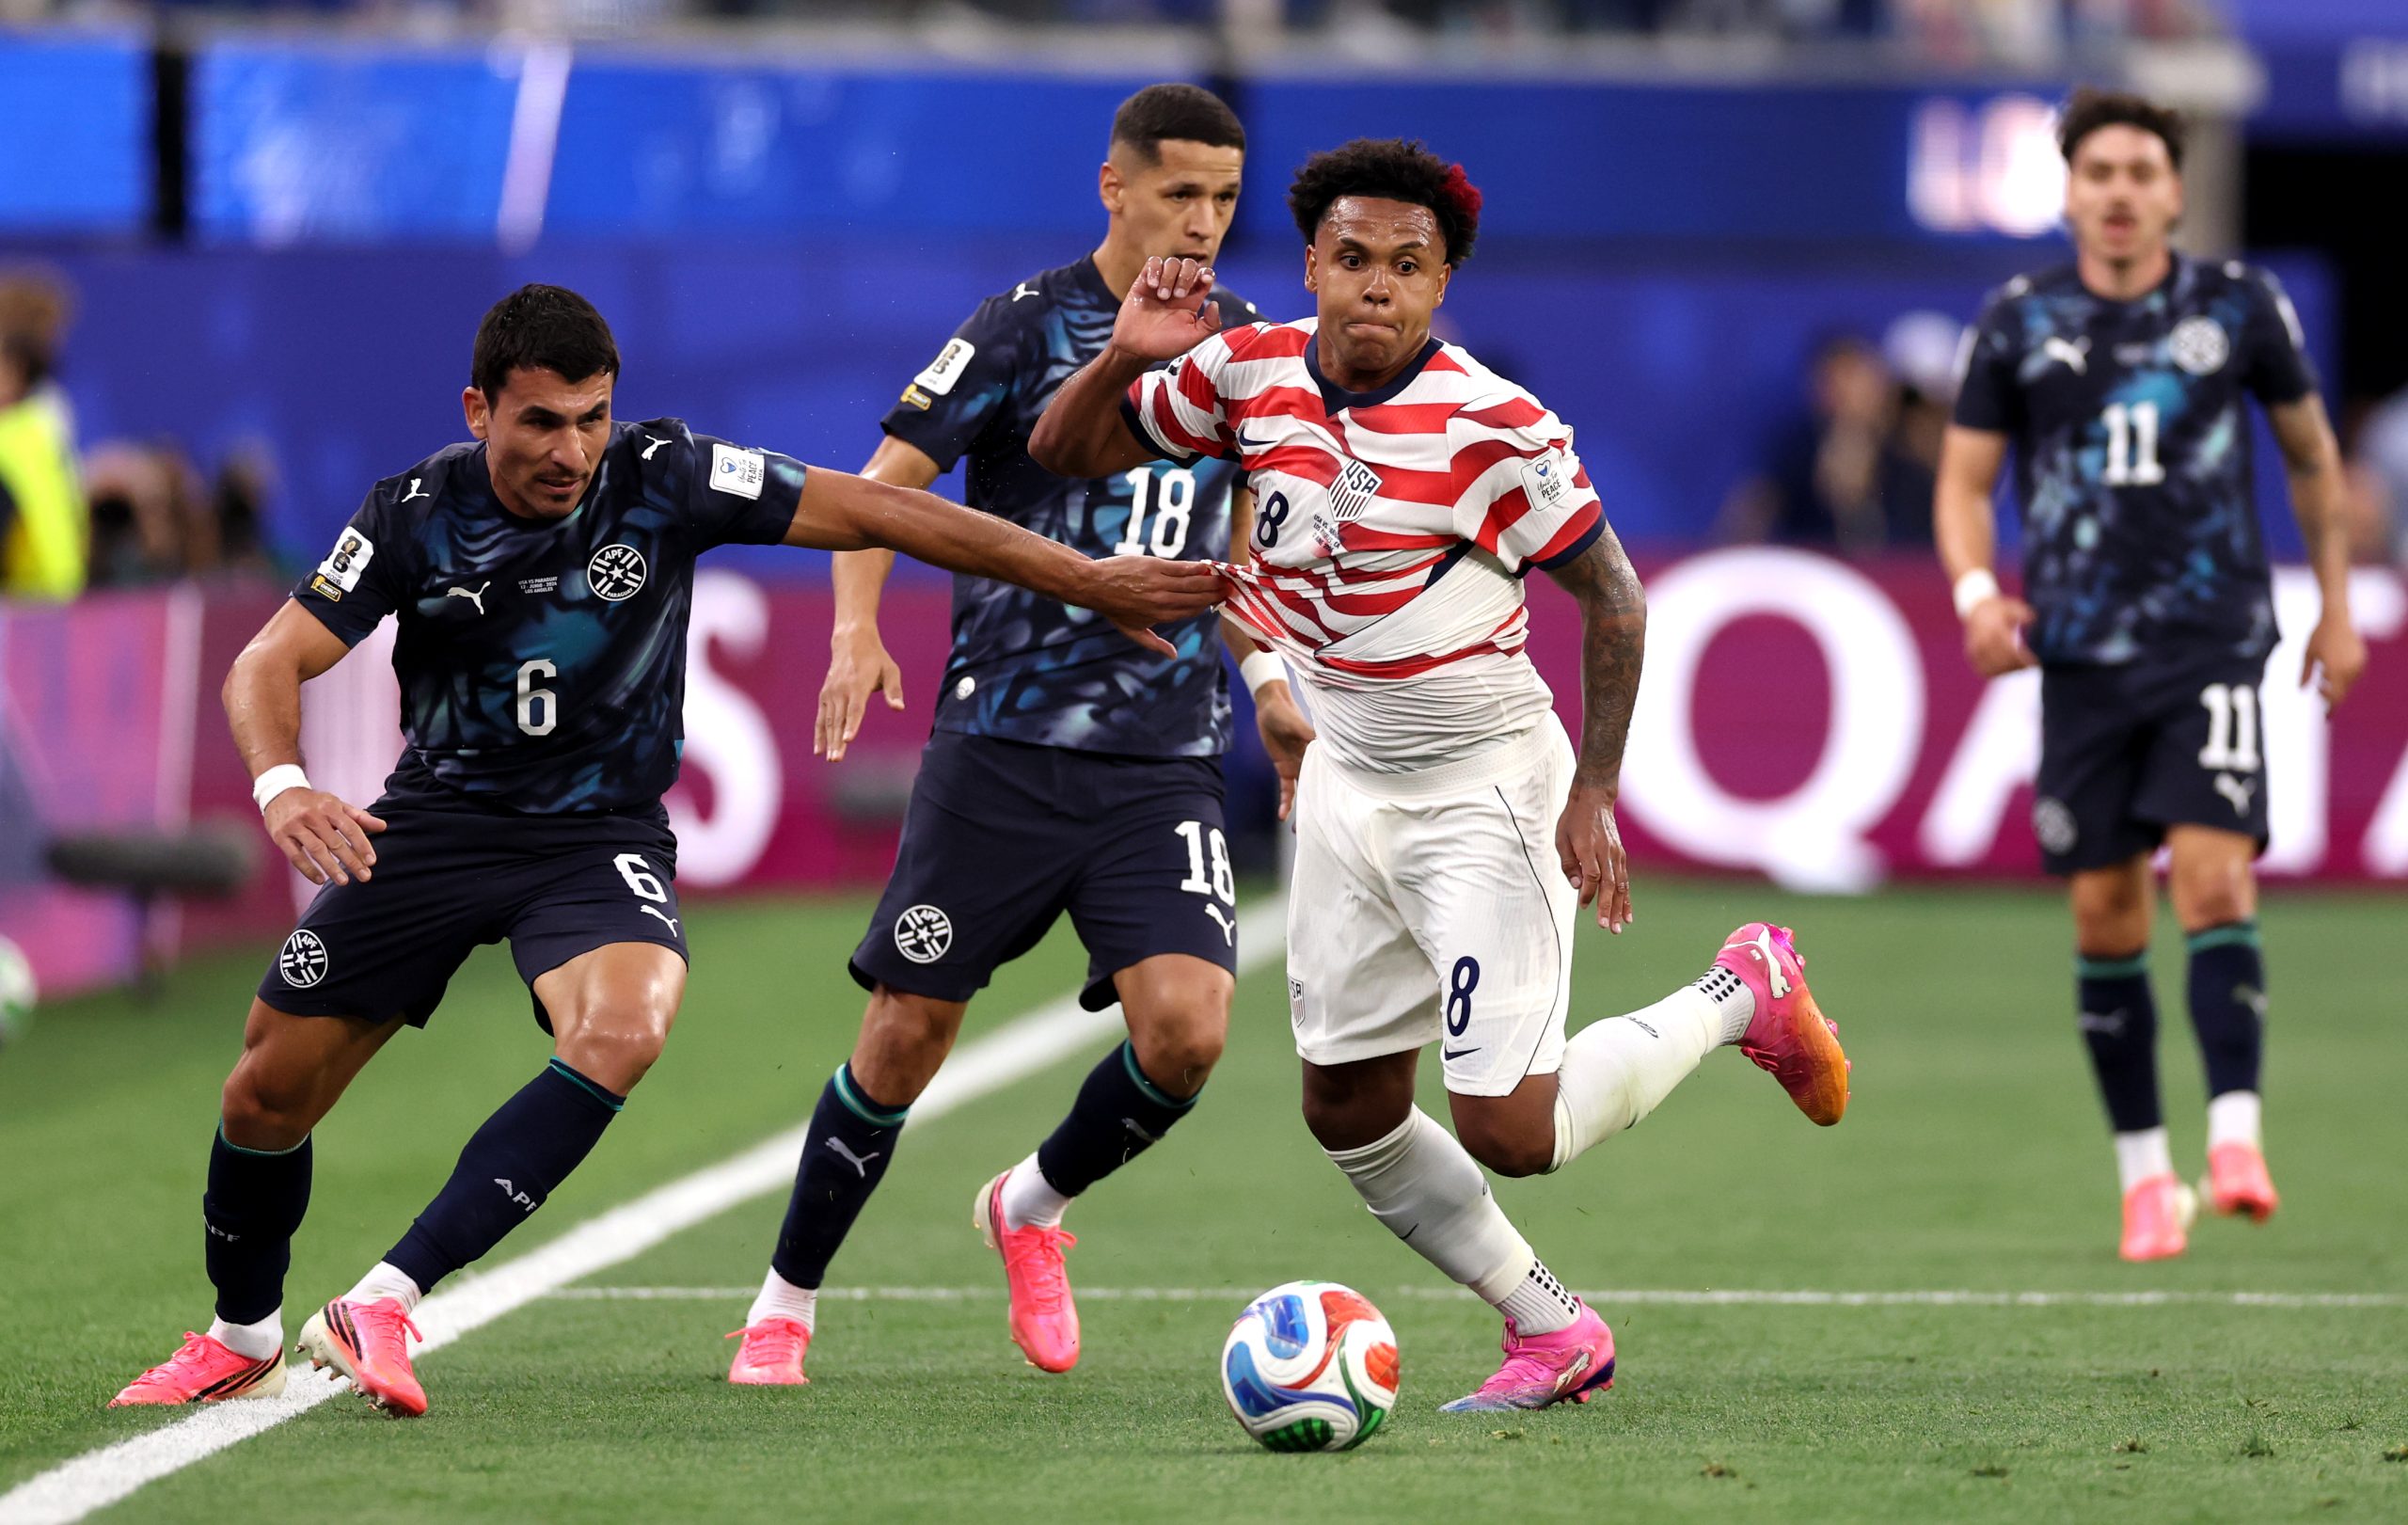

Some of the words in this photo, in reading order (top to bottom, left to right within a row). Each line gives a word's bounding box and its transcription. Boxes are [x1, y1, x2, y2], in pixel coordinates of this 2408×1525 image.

[2099, 401, 2166, 485] 11
[747, 460, 758, 484] PEACE
[1346, 460, 1379, 495] USA
[1541, 479, 1561, 499] PEACE
[1114, 467, 1196, 559] 18
[1257, 490, 1290, 548] 8
[1313, 514, 1323, 525] USA
[604, 548, 624, 562] APF
[1333, 540, 1341, 549] CA
[320, 583, 339, 596] DEBUT
[325, 572, 342, 586] 2026
[606, 587, 633, 598] PARAGUAY
[517, 659, 557, 736] 6
[2197, 683, 2260, 773] 11
[612, 853, 668, 903] 6
[1174, 820, 1235, 907] 18
[301, 934, 318, 949] APF
[1447, 955, 1481, 1037] 8
[494, 1178, 537, 1212] APF
